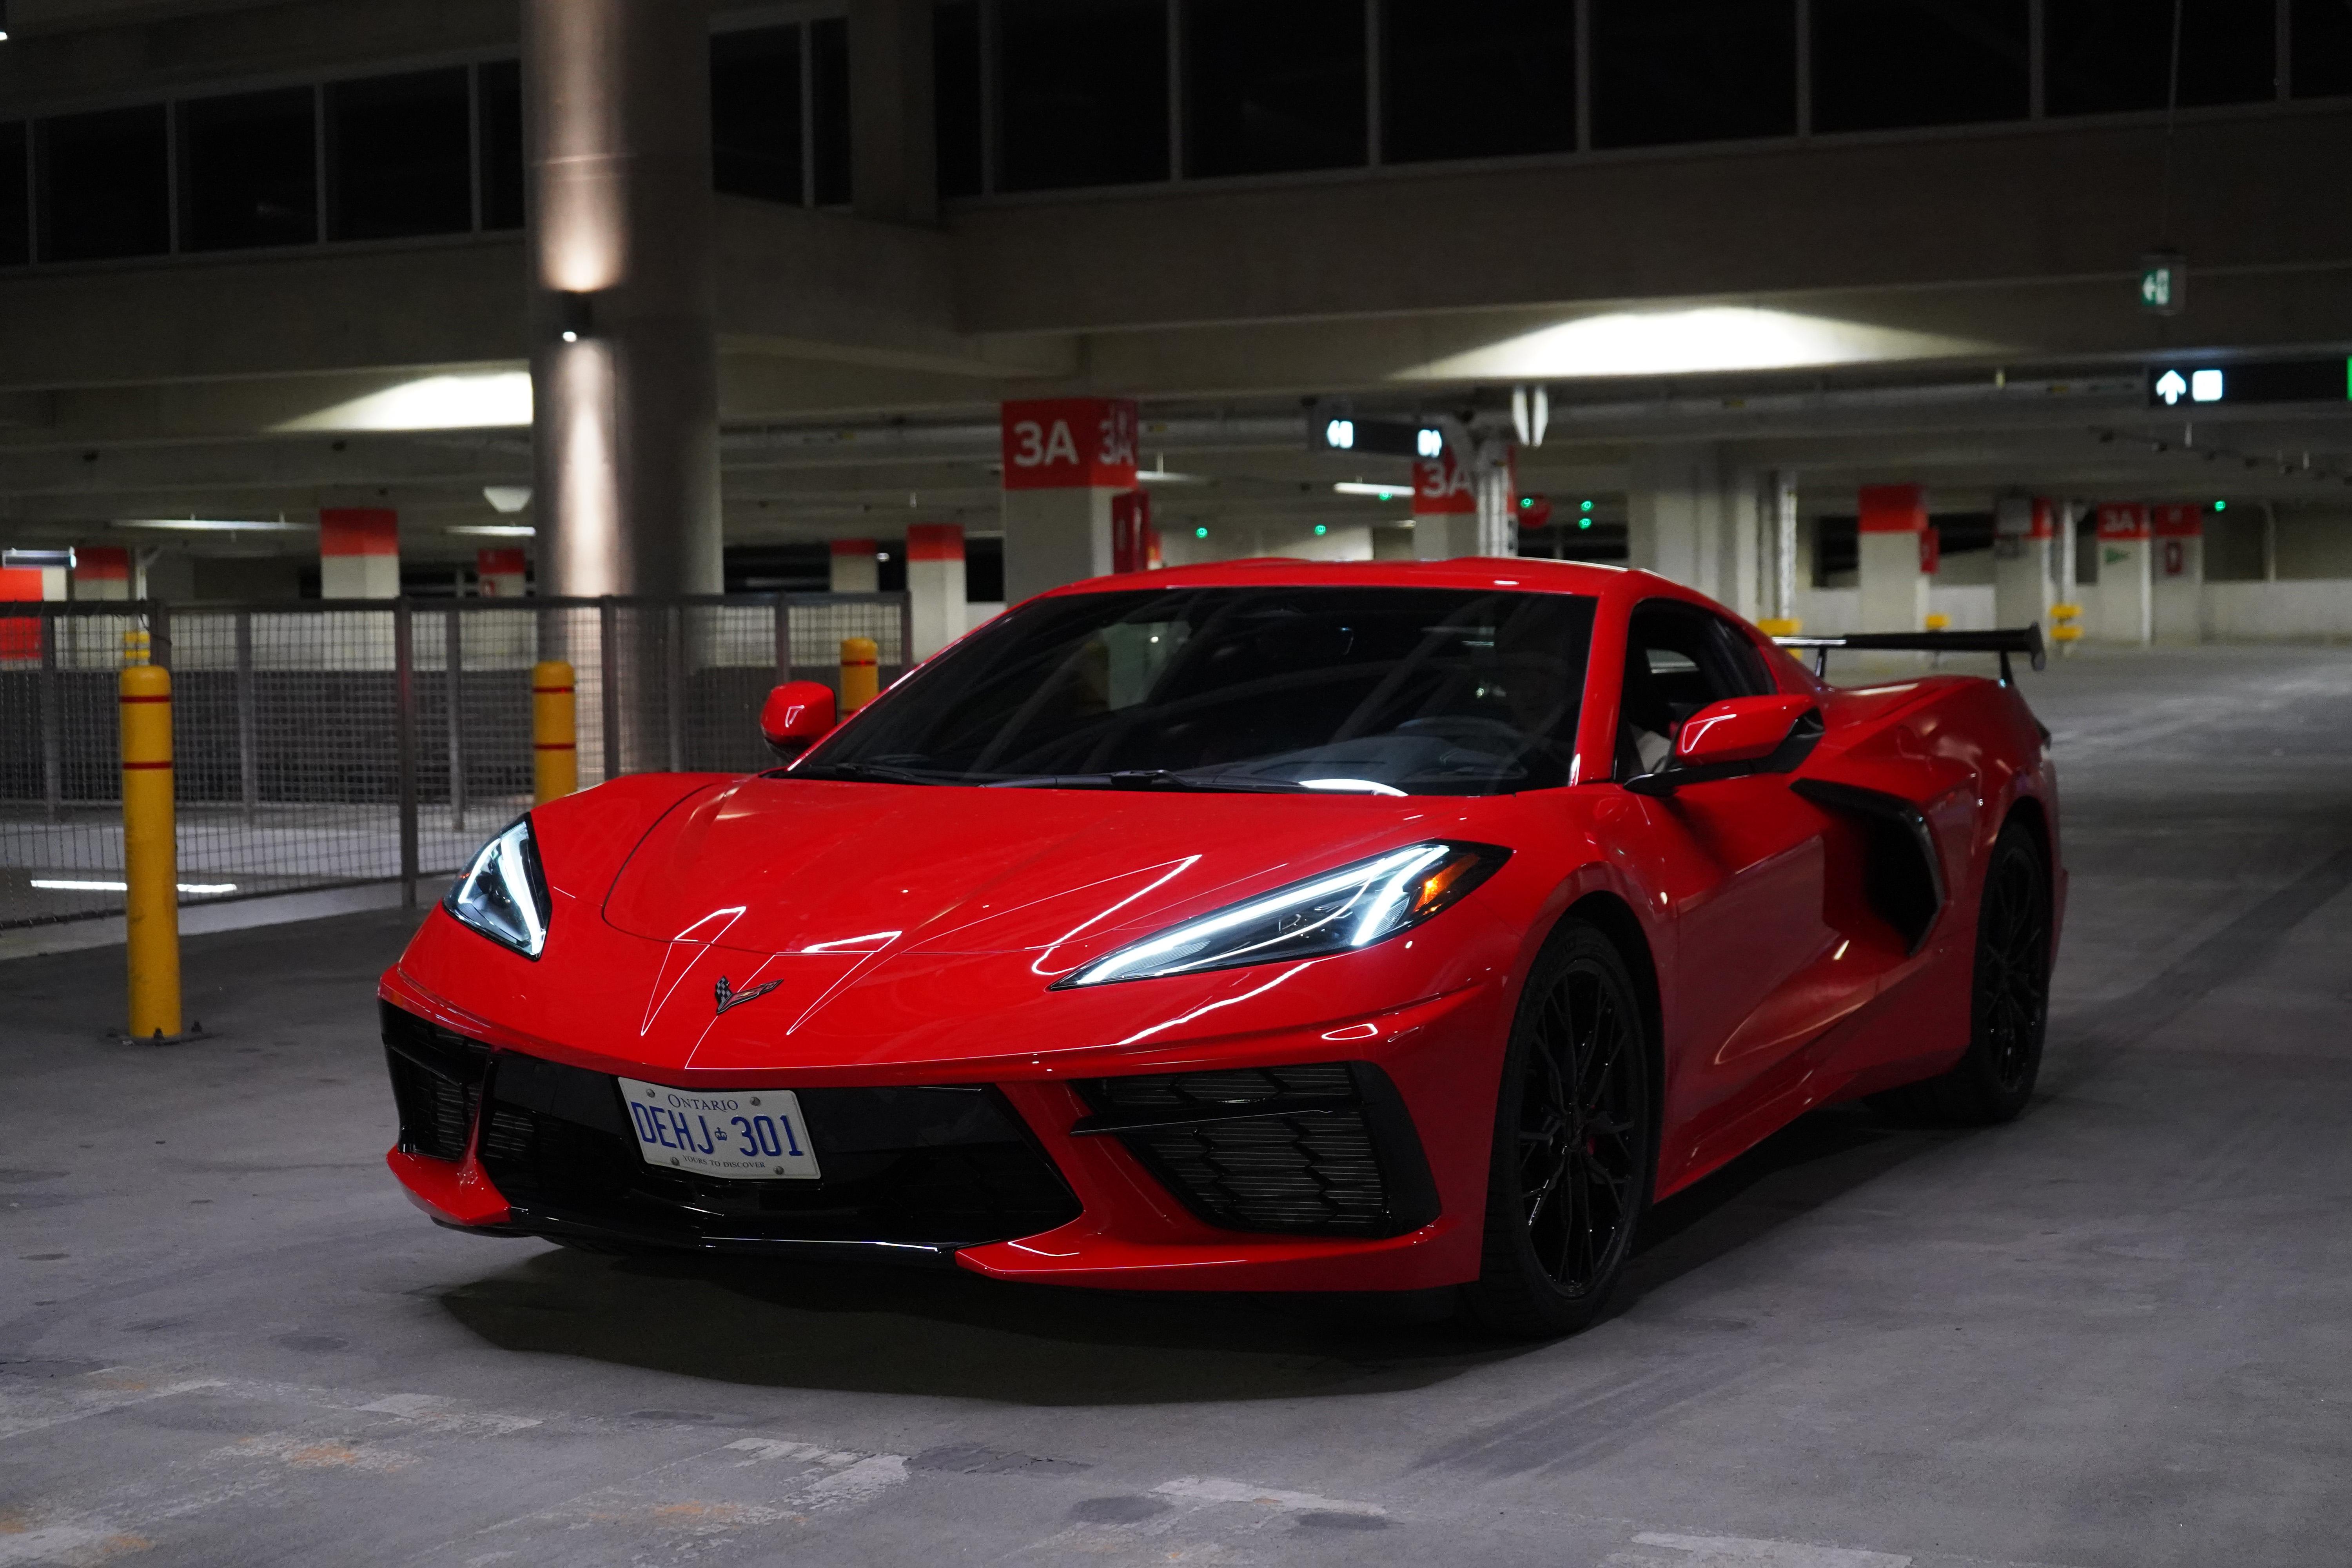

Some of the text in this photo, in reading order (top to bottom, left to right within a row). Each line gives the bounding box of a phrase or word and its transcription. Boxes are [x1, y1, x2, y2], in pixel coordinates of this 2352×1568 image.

[1013, 419, 1080, 467] 3A
[1098, 418, 1135, 465] 3A
[1421, 461, 1476, 498] 3A
[668, 1094, 738, 1112] ONTARIO
[631, 1102, 803, 1157] DEHJ 301
[682, 1155, 707, 1165] YOURS
